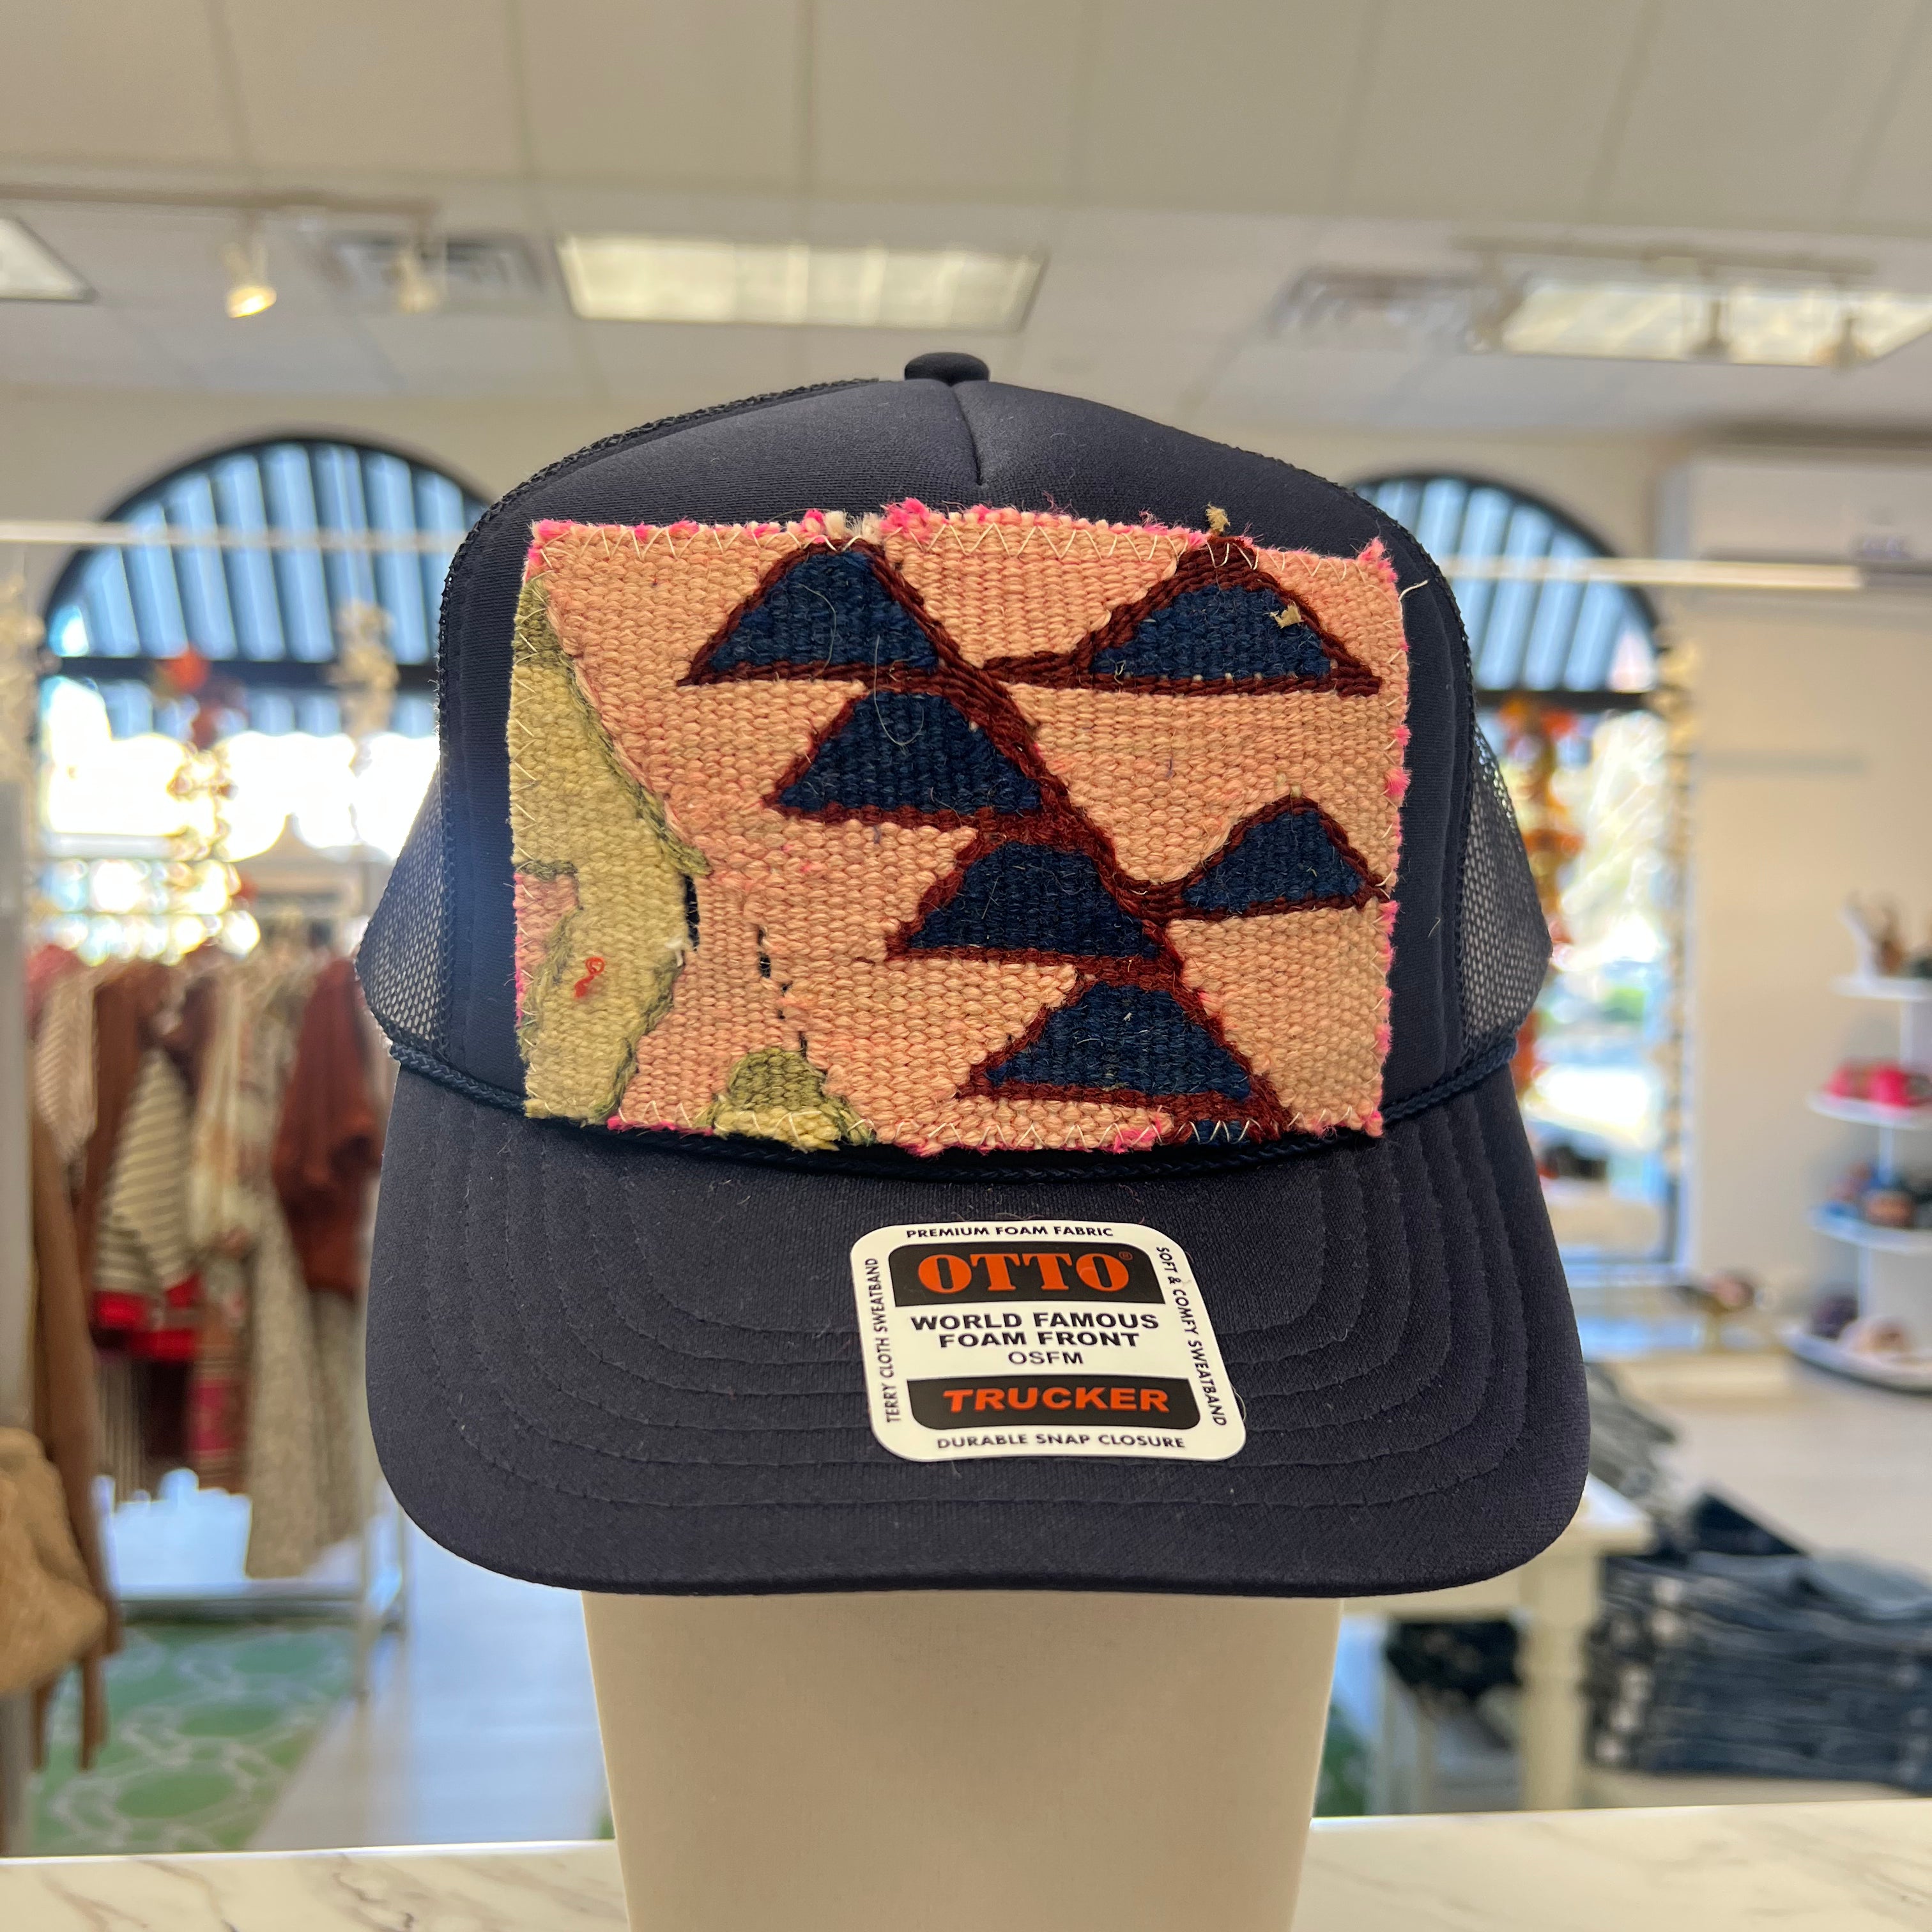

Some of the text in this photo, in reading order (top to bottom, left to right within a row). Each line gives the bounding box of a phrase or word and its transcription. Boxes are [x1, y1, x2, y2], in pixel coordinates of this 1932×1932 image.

[907, 1226, 1114, 1238] PREMIUM FOAM FABRIC
[911, 1313, 1159, 1330] WORLD FAMOUS
[864, 1258, 901, 1423] TERRY CLOTH SWEATBAND
[939, 1332, 1140, 1347] FOAM FRONT
[1156, 1246, 1227, 1425] SOFT & COMFY SWEATBAND
[1008, 1351, 1084, 1365] OSFM
[942, 1387, 1170, 1413] TRUCKER
[938, 1434, 1185, 1449] DURABLE SNAP CLOSURE
